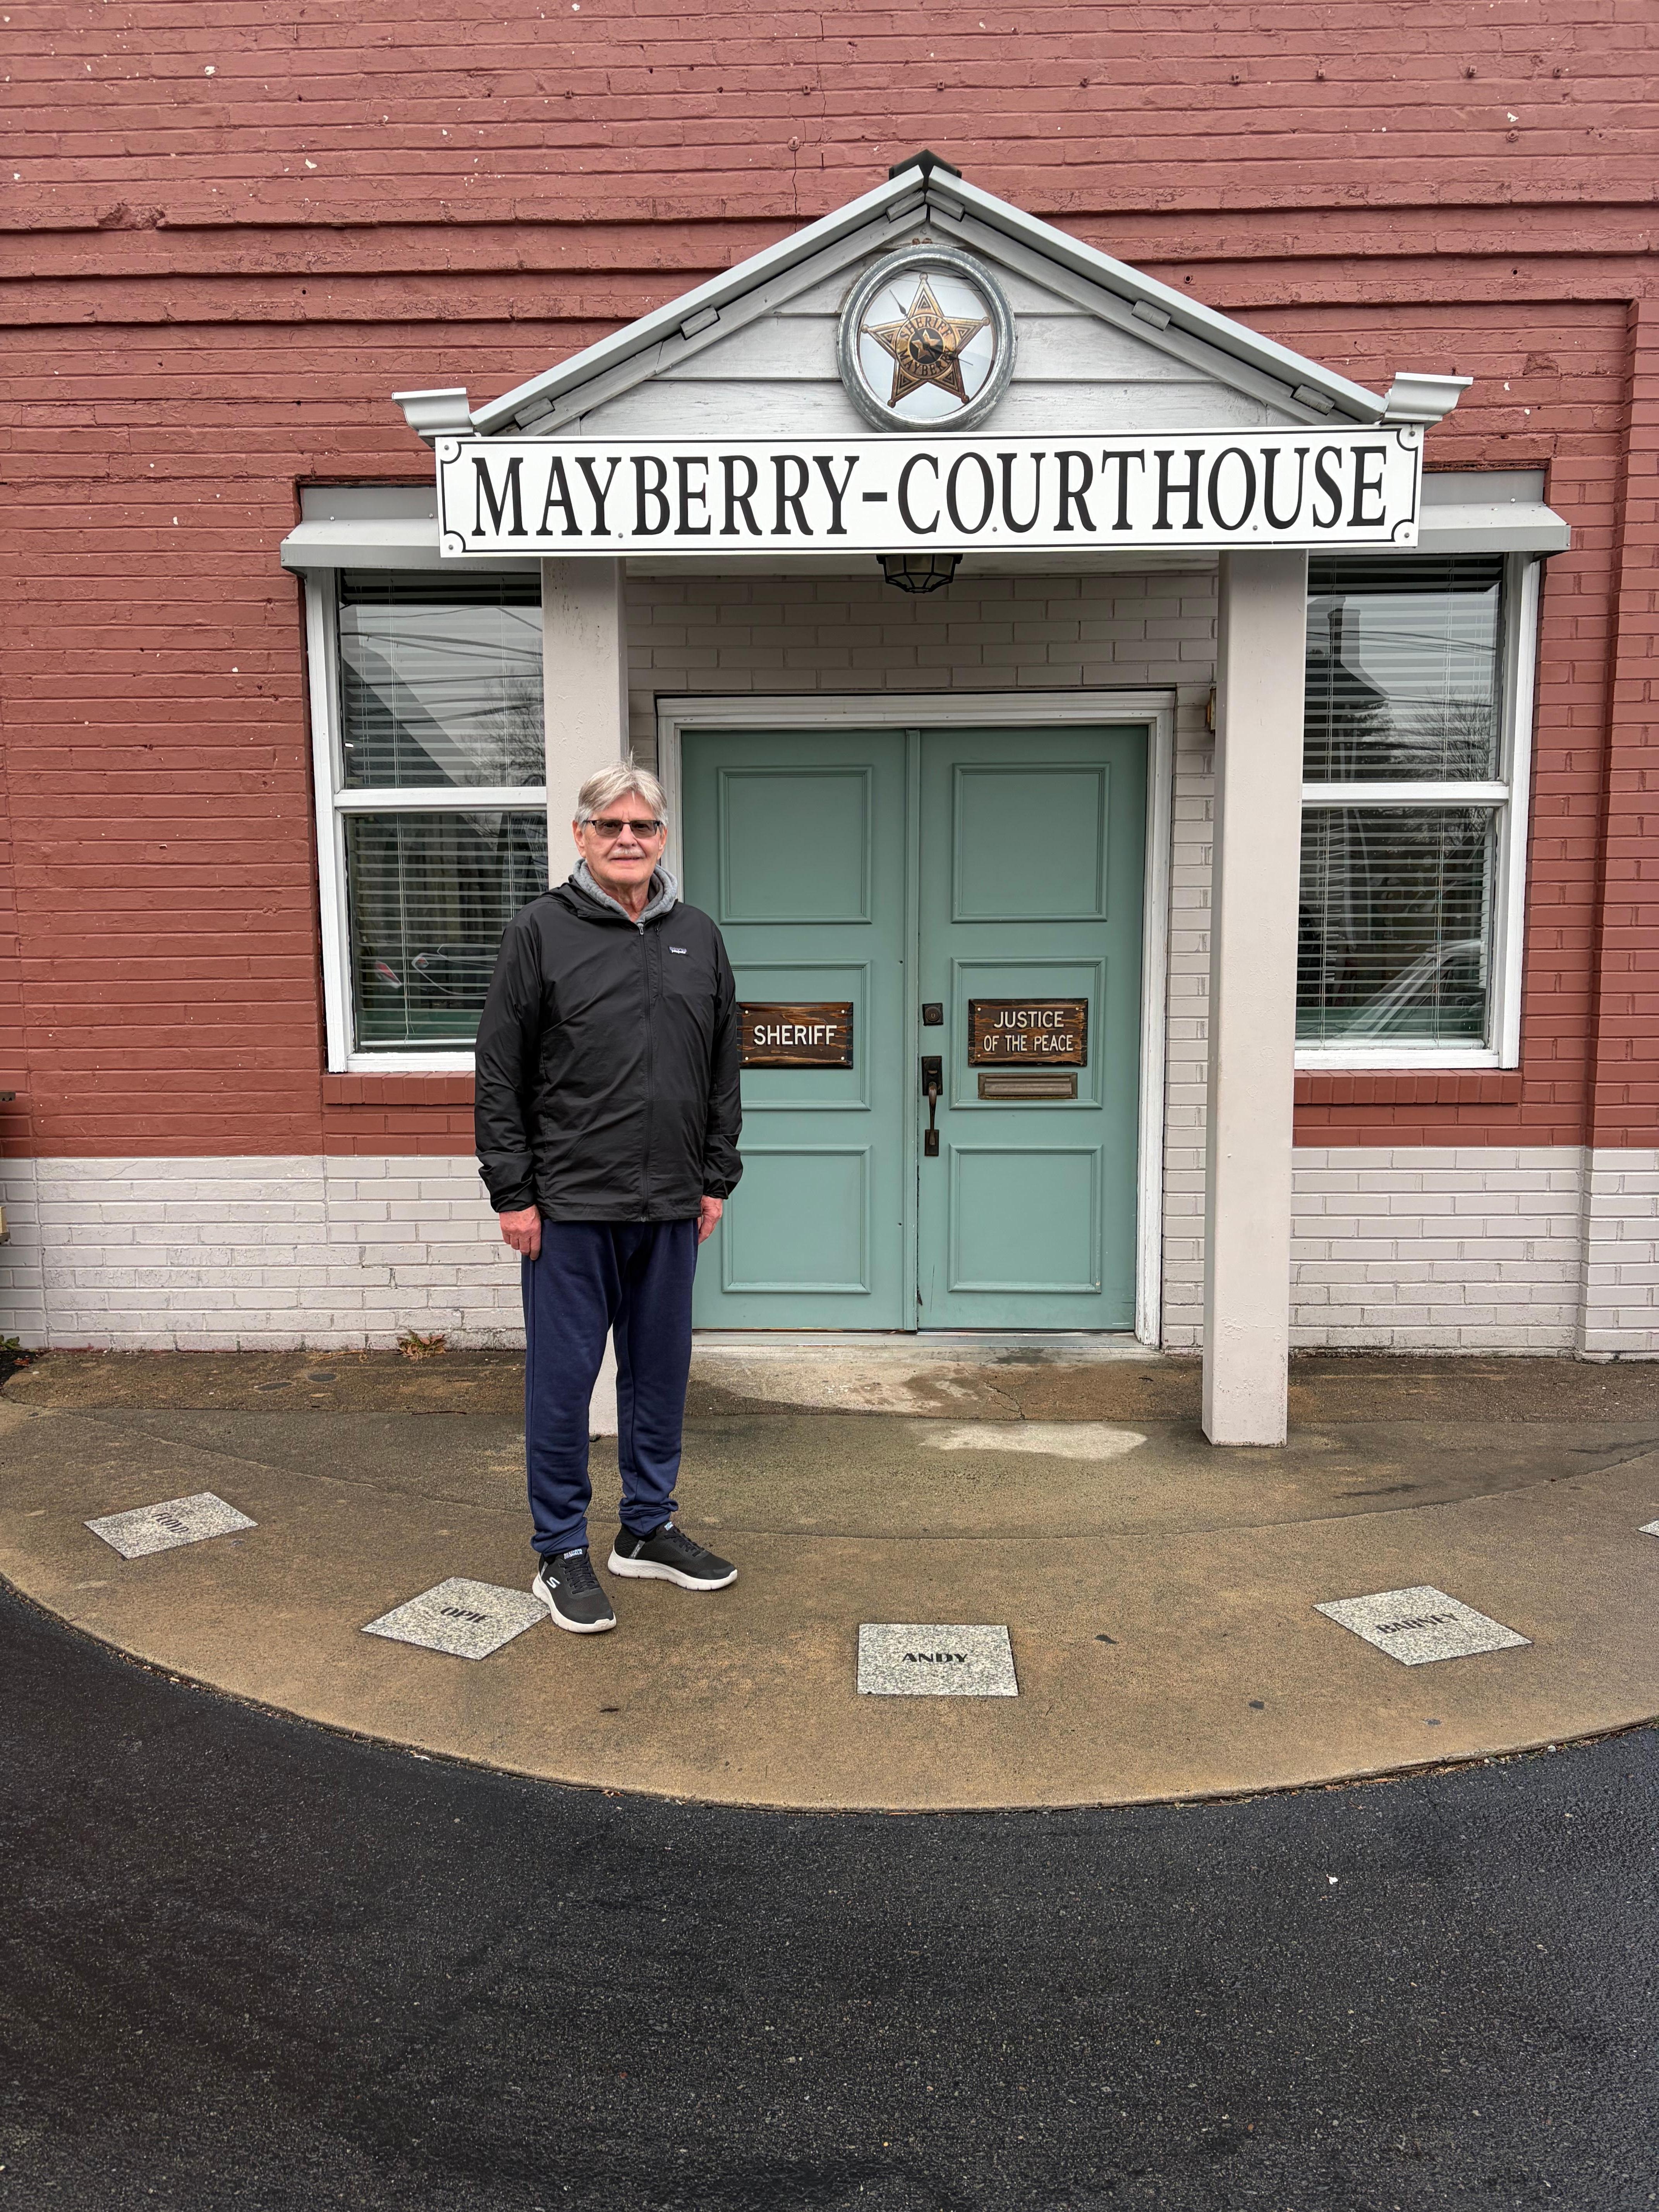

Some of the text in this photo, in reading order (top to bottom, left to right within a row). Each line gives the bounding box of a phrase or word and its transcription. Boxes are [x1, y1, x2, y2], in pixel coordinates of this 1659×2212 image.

[899, 316, 954, 340] SHERIFF
[898, 345, 957, 376] MAYBERRY
[471, 445, 1387, 536] MAYBERRY-COURTHOUSE
[994, 1011, 1064, 1028] JUSTICE
[753, 1024, 838, 1046] SHERIFF
[983, 1034, 1073, 1052] OF THE PEACE
[151, 1512, 189, 1534] FLOYD
[440, 1607, 492, 1623] OPIE
[1375, 1612, 1461, 1634] BARNEY
[902, 1653, 969, 1663] ANDY
